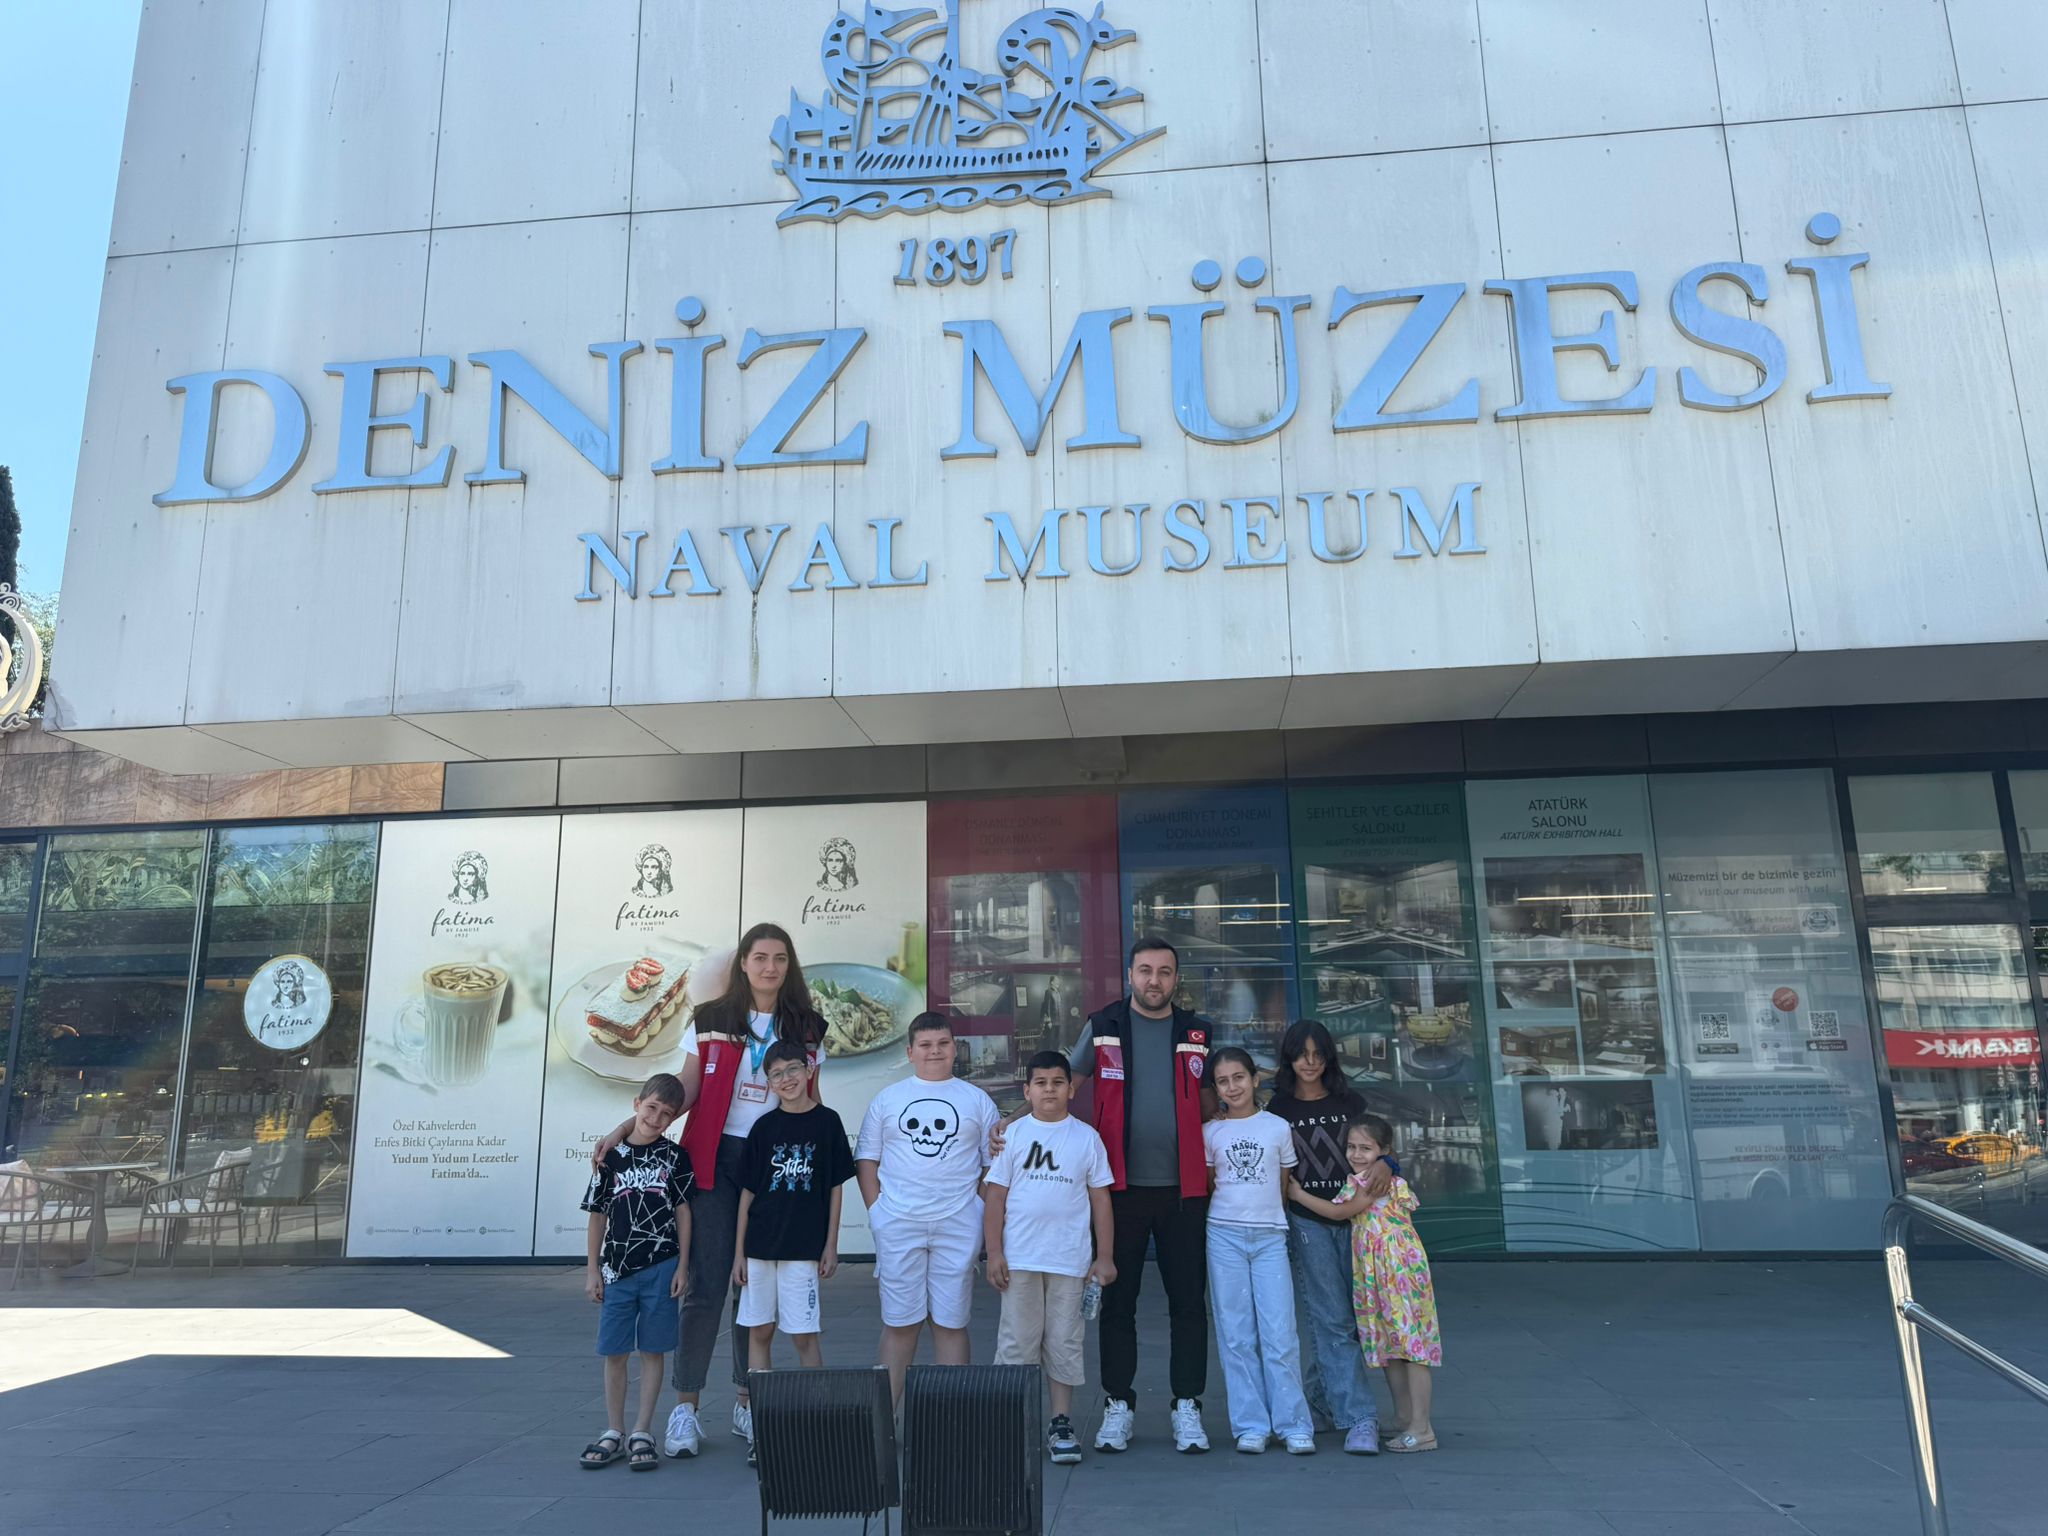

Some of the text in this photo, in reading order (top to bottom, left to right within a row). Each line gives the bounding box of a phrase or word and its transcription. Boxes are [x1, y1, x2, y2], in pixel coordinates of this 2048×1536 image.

[893, 228, 1017, 287] 1897
[151, 211, 1892, 507] DENİZ MÜZESİ
[574, 482, 1488, 602] NAVAL MUSEUM
[1371, 806, 1391, 817] VE
[1393, 800, 1451, 816] GAZİLER
[1528, 795, 1588, 811] ATATÜRK
[1352, 822, 1406, 834] SALONU
[1531, 815, 1587, 828] SALONU
[1543, 829, 1598, 839] EXHIBITION
[1599, 828, 1623, 837] HALL
[1667, 868, 1837, 882] Müzemizi bir de bizimle gezin!
[1697, 886, 1720, 897] Visit
[1743, 887, 1785, 896] museum
[1788, 884, 1811, 895] with
[615, 901, 681, 931] fatima
[802, 895, 867, 925] fatima
[430, 907, 495, 937] fatima
[258, 1012, 313, 1040] fatima
[392, 1119, 477, 1131] Özel Kahvelerden
[374, 1136, 507, 1150] Enfes Bitki Çaylarına Kadar
[1231, 1142, 1259, 1152] MAGIC
[392, 1152, 519, 1164] Yudum Yudum Lezzetler
[770, 1153, 814, 1178] Stitch
